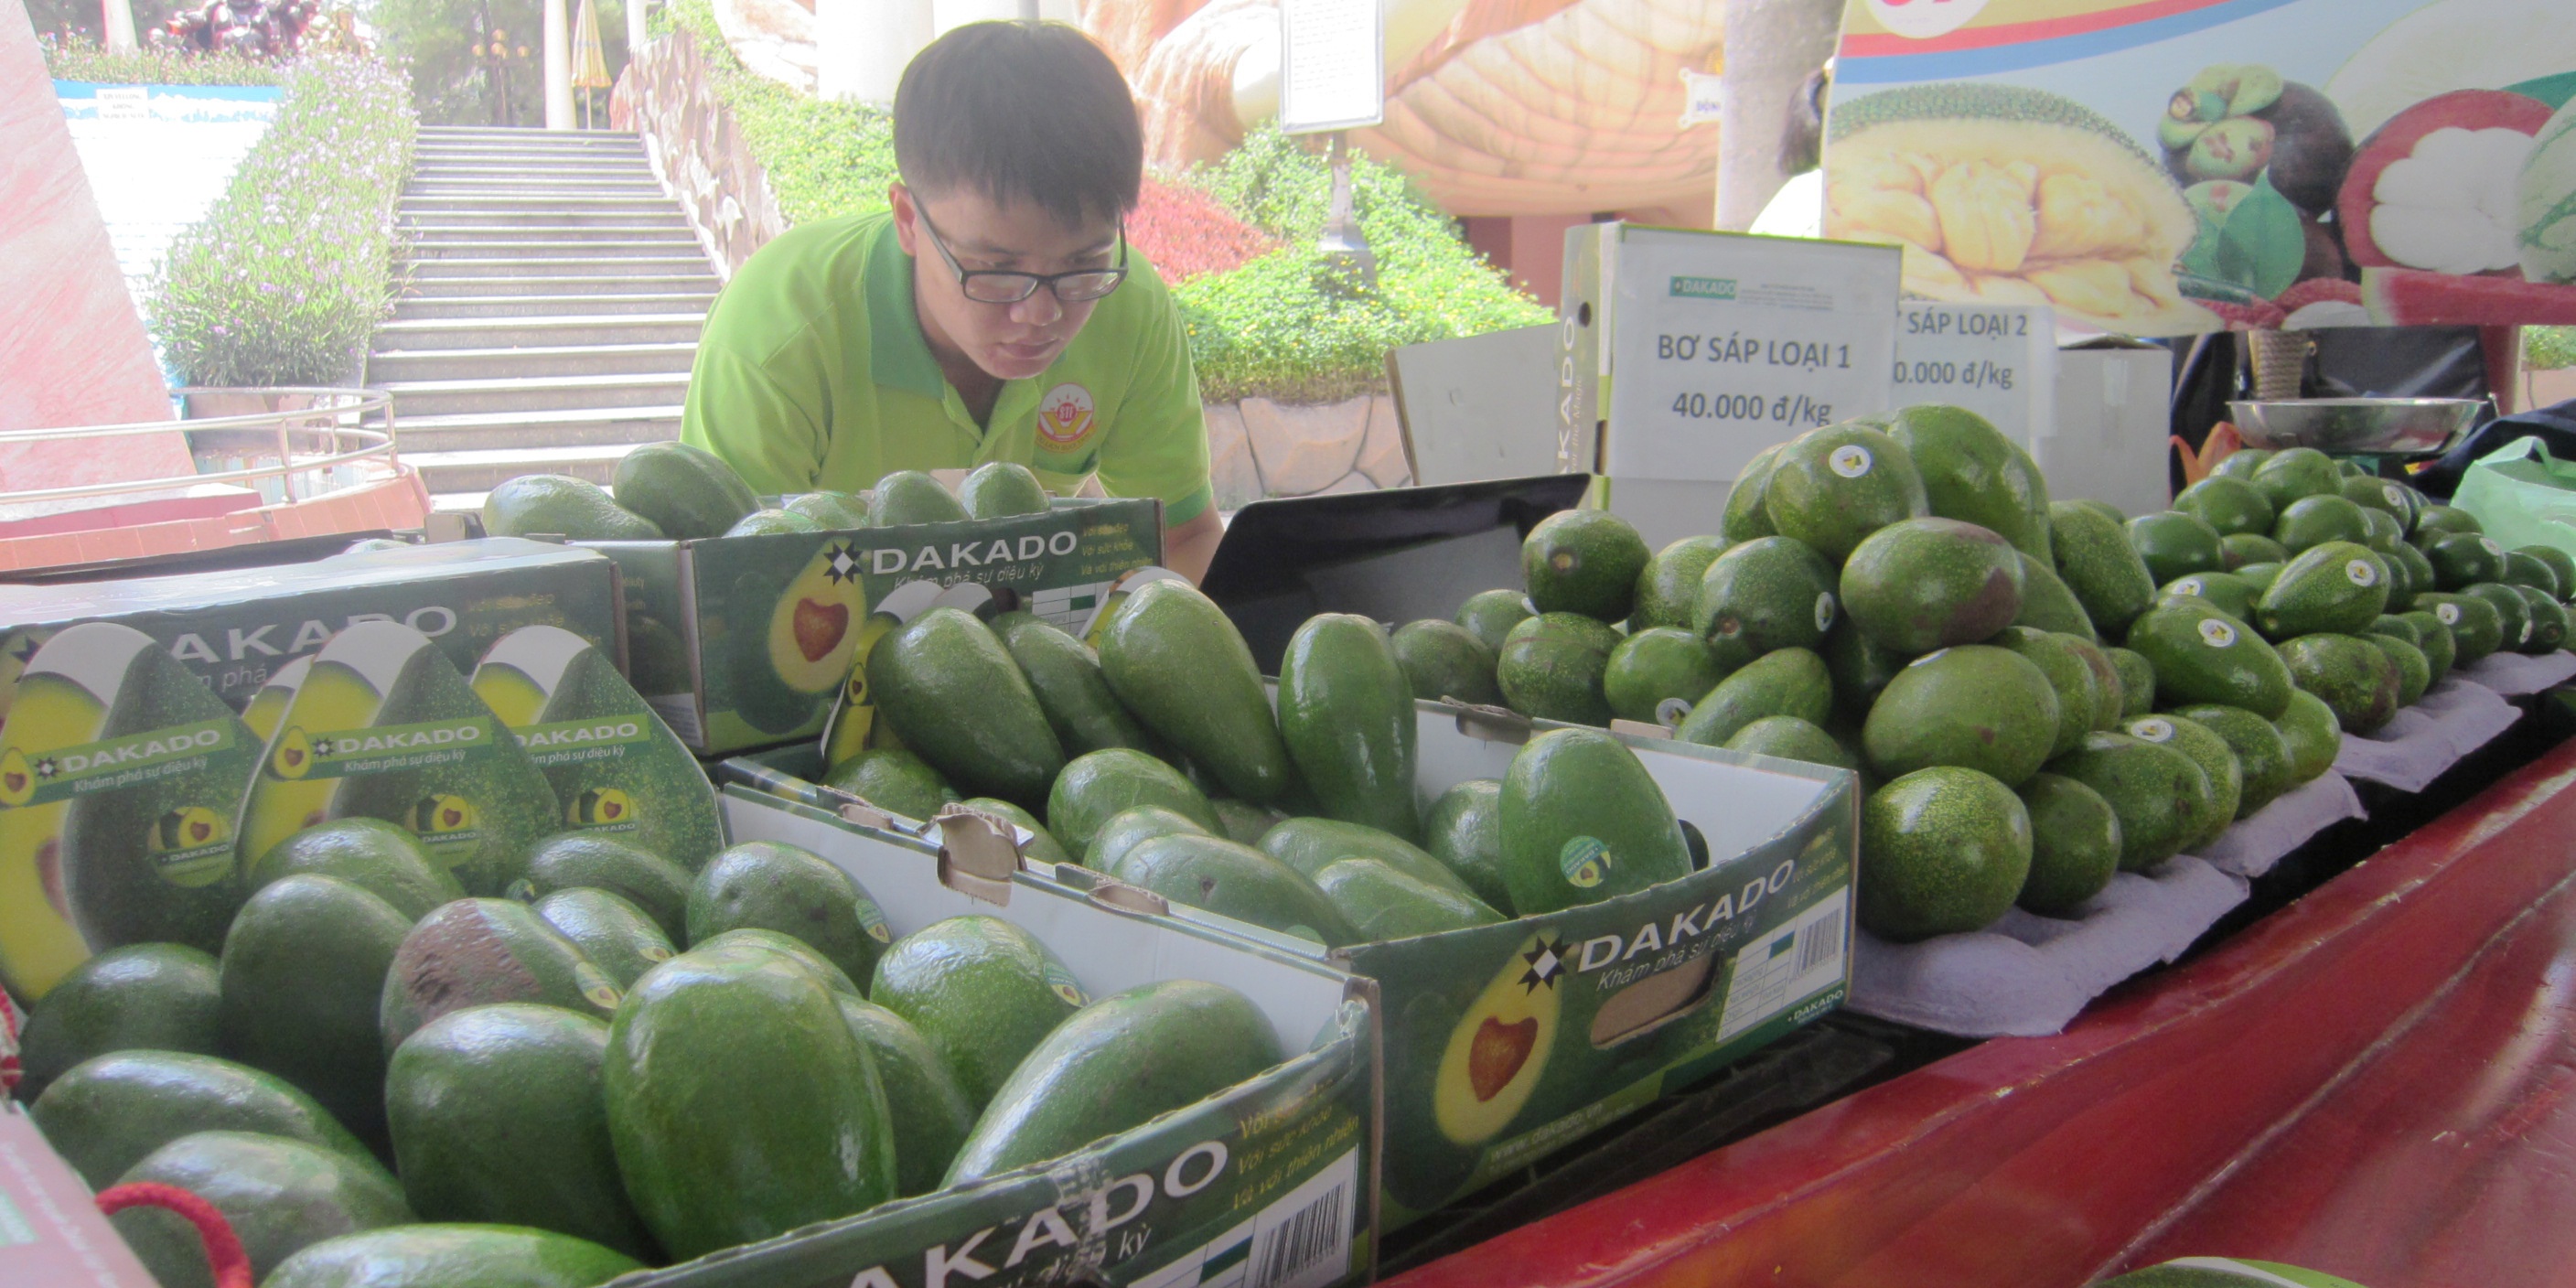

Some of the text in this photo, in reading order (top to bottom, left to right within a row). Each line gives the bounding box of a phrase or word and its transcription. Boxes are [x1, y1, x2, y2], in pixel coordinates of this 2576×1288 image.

[1907, 306, 2027, 341] SÁP LOẠI 2
[1658, 331, 1851, 373] BƠ SÁP LOẠI 1
[1894, 360, 2012, 391] 0.000 đ/kg
[1558, 317, 1574, 474] KADO
[1672, 392, 1831, 427] 40.000 đ/kg
[874, 531, 1078, 574] DAKADO
[170, 606, 457, 663] AKAO
[60, 729, 221, 773] DAKADO
[337, 725, 480, 754] DAKADO
[548, 748, 570, 765] phá
[344, 757, 381, 772] Khám
[382, 753, 407, 770] phá
[169, 844, 230, 862] DAKADO
[423, 832, 477, 843] DAKADO
[1578, 859, 1795, 972] DAKADO
[1595, 961, 1650, 993] Khám
[1794, 989, 1843, 1020] DAKADO
[1117, 1222, 1153, 1261] kỳ
